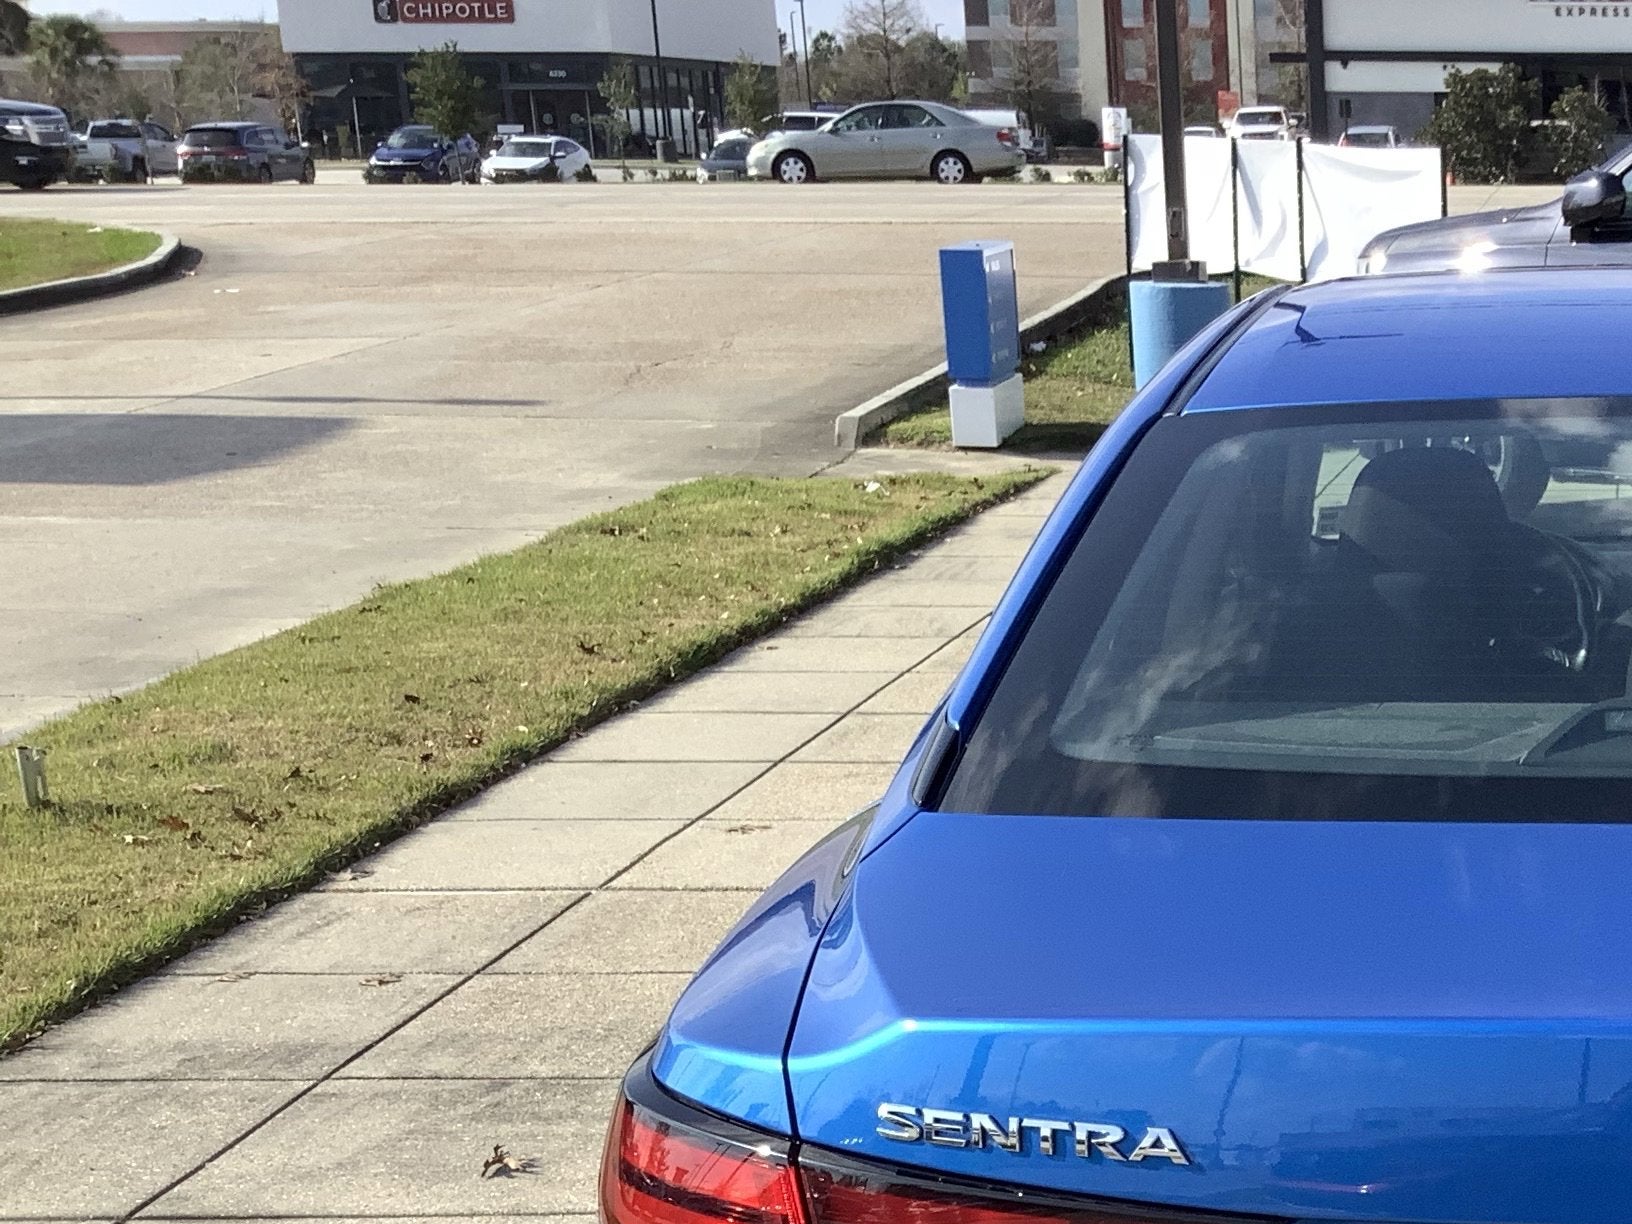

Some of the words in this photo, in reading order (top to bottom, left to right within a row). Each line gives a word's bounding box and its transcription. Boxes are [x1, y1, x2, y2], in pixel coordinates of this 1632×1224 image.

[403, 2, 509, 18] CHIPOTLE
[1554, 6, 1630, 17] EXPRESS
[876, 1102, 1191, 1165] SENTRA
